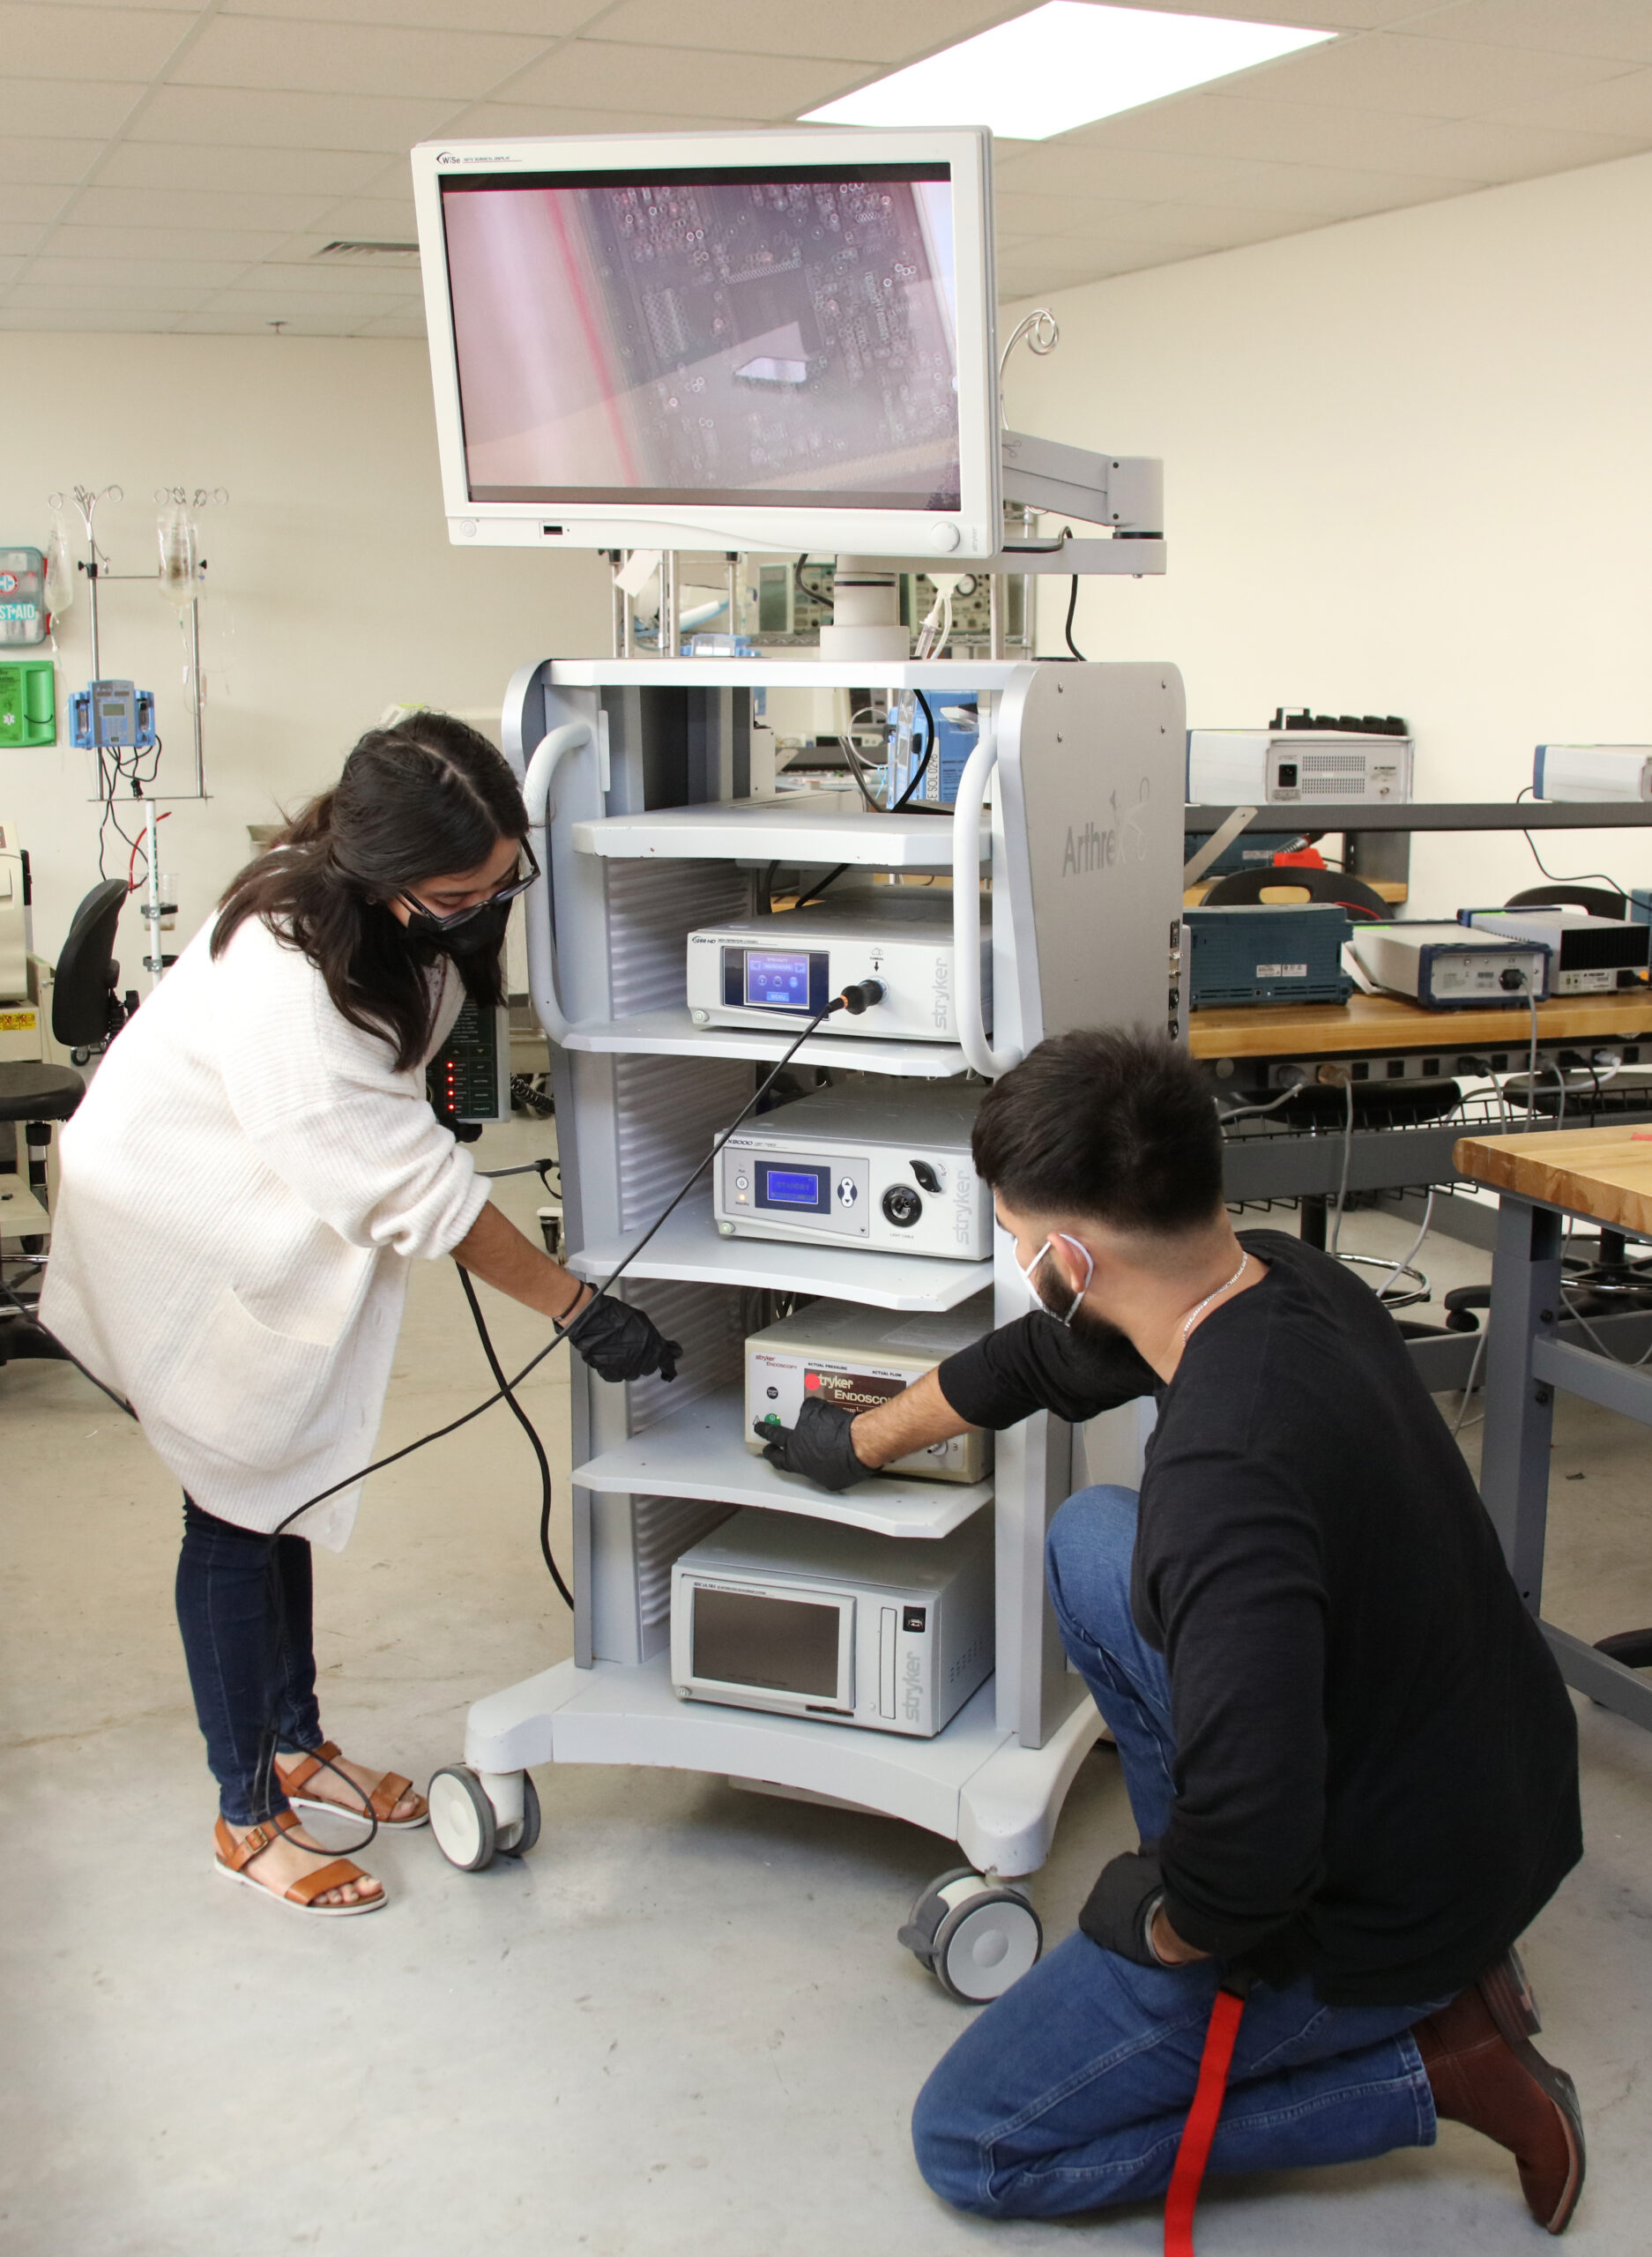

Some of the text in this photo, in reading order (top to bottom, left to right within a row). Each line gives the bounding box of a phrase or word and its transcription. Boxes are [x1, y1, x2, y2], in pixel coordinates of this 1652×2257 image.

[16, 604, 35, 620] AID
[926, 776, 938, 791] SOL
[932, 957, 949, 1030] stryker
[777, 1181, 810, 1191] STANDBY
[953, 1171, 972, 1245] stryker
[818, 1373, 853, 1389] tryker
[834, 1389, 891, 1404] ENDOSCO
[902, 1650, 923, 1723] stryker
